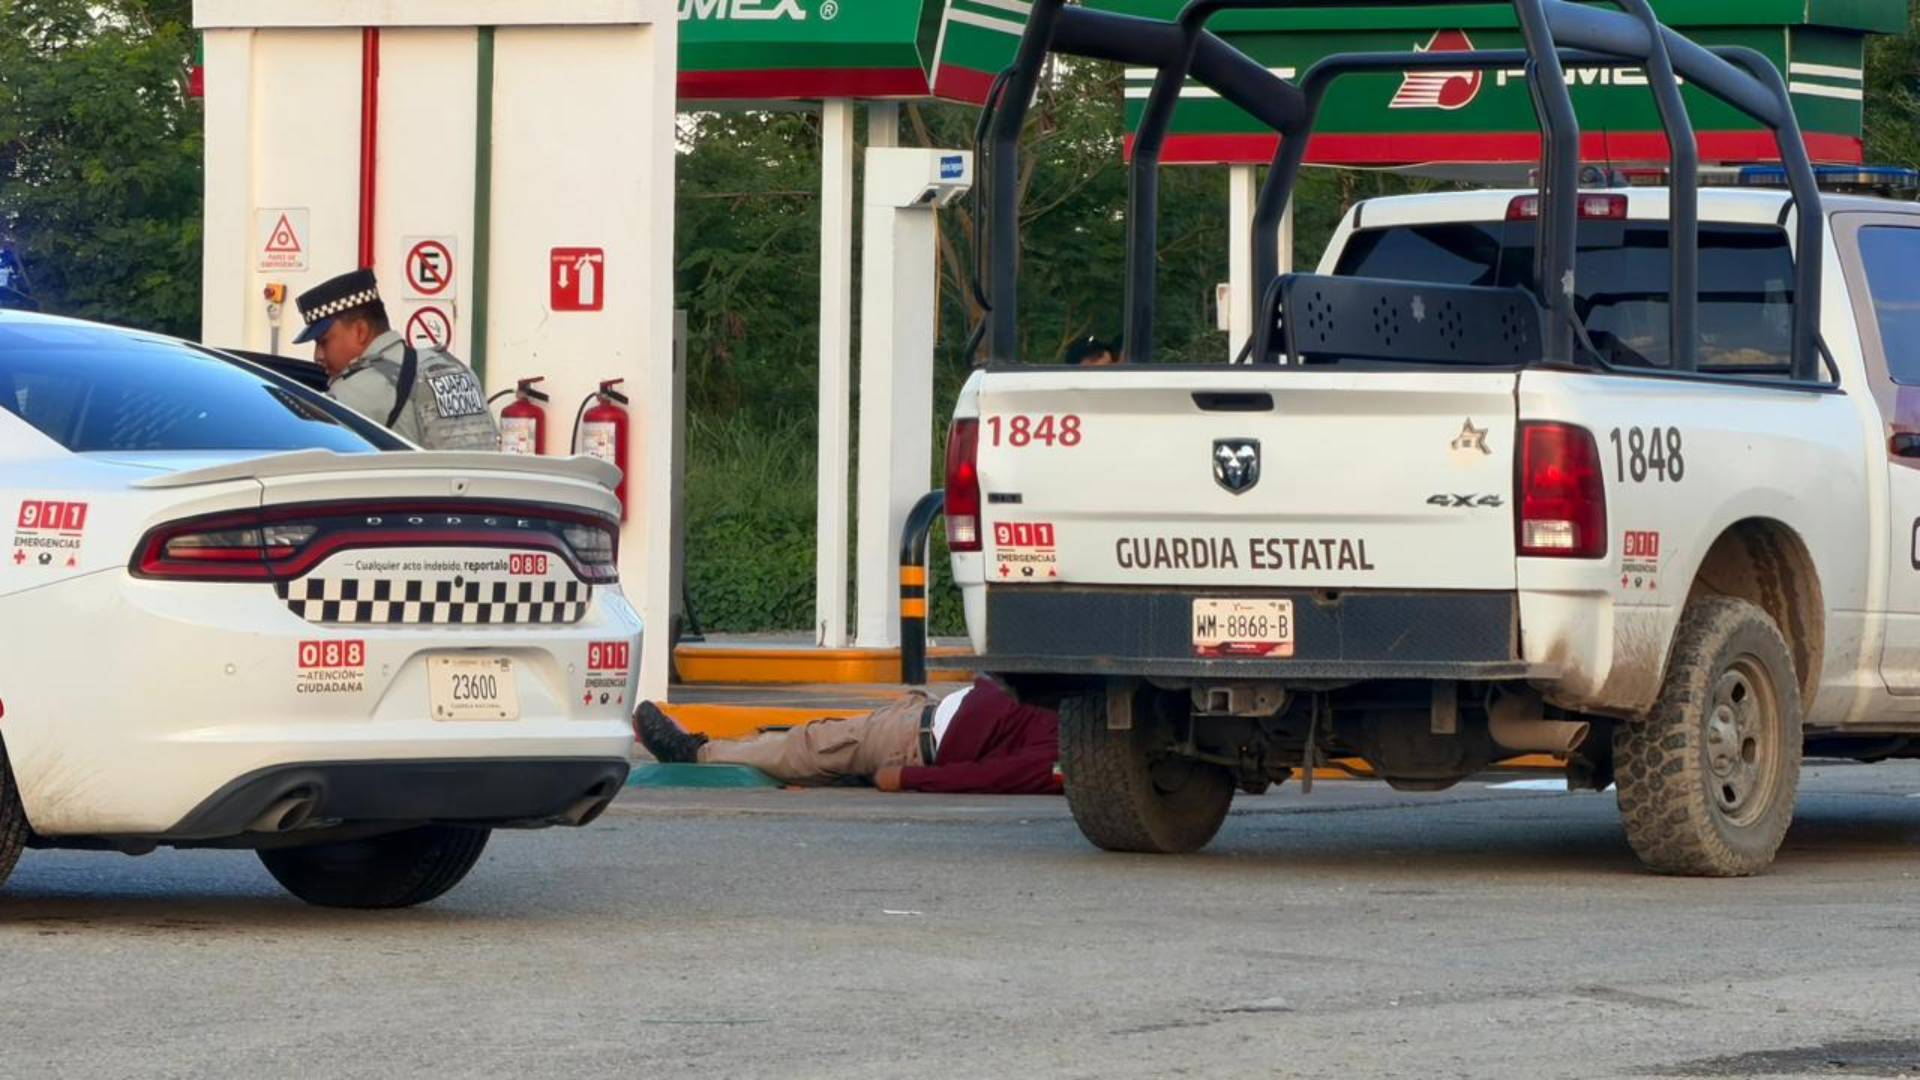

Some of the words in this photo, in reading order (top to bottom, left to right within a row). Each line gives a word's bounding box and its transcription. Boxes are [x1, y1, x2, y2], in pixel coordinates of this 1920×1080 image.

[987, 414, 1081, 447] 1848
[1610, 426, 1684, 483] 1848
[21, 503, 82, 528] 911
[366, 516, 529, 528] DODGE
[14, 536, 81, 549] EMERGENCIAS
[996, 524, 1050, 545] 911
[1625, 533, 1657, 556] 911
[355, 559, 401, 573] Cualquier
[402, 560, 422, 571] acto
[511, 555, 546, 574] 088
[996, 552, 1057, 563] EMERGENCIAS
[1115, 537, 1239, 570] GUARDIA
[1248, 538, 1376, 571] ESTATAL
[1196, 614, 1288, 639] WM-8868-B
[301, 642, 361, 666] 088
[589, 644, 627, 667] 911
[296, 682, 363, 693] CIUDADANA
[452, 673, 497, 700] 23600
